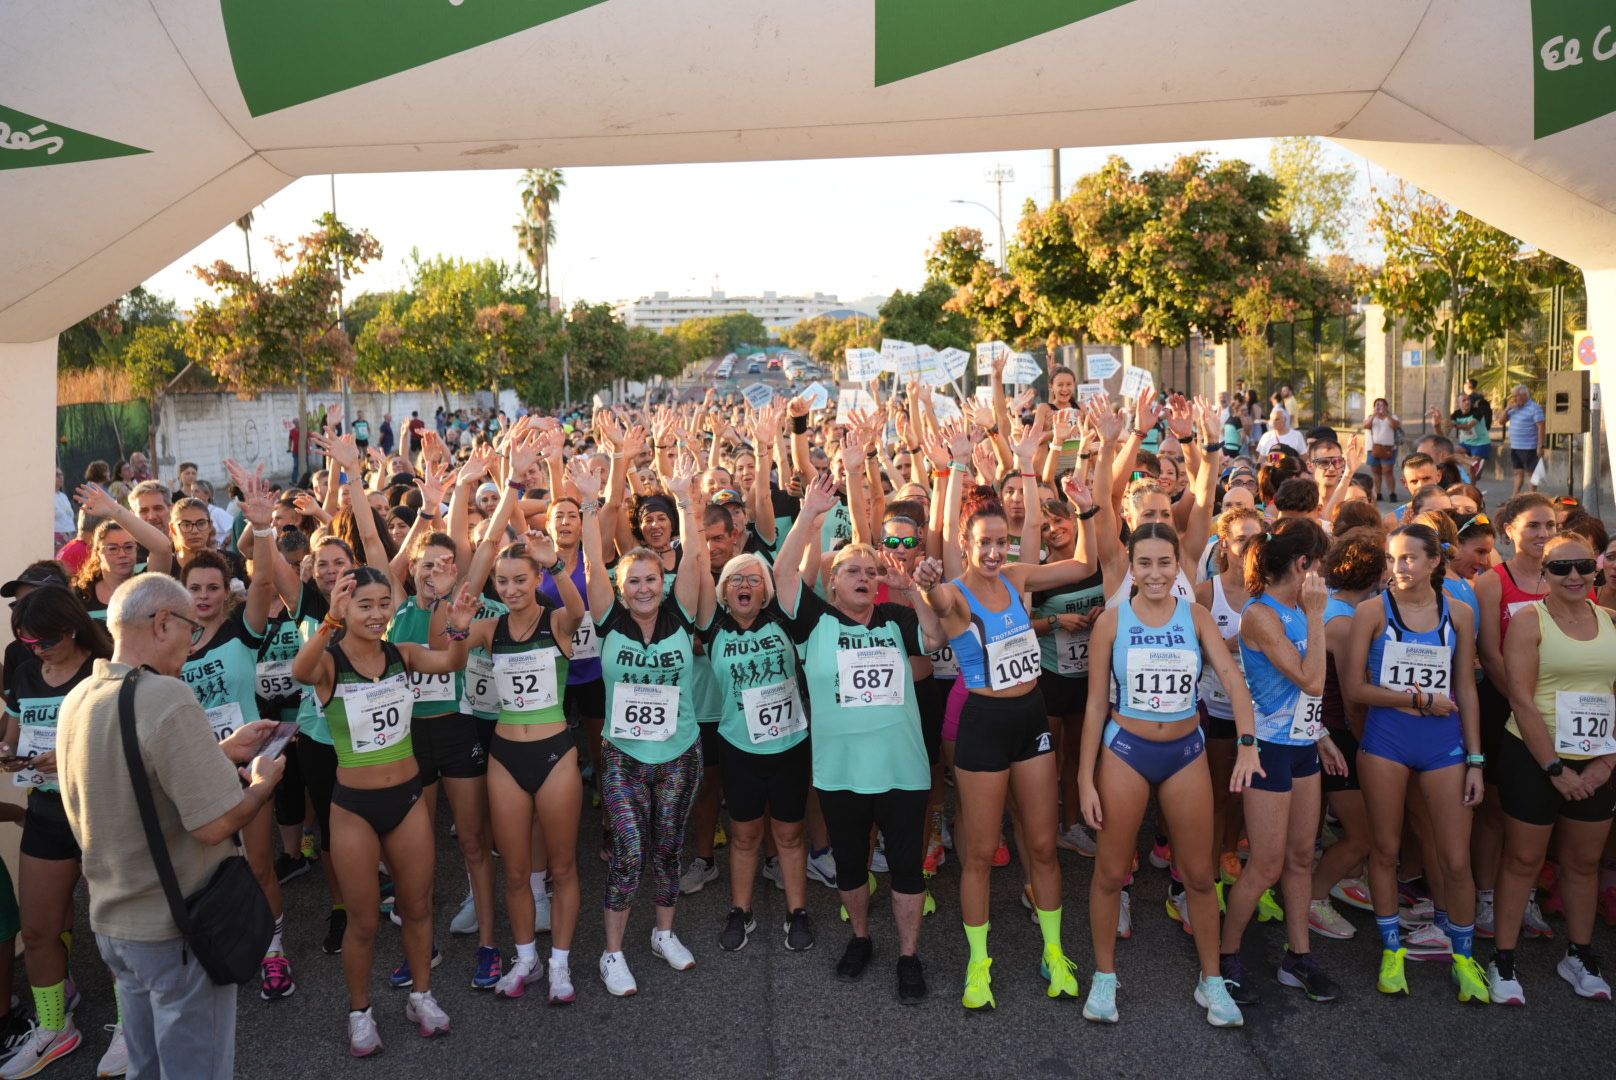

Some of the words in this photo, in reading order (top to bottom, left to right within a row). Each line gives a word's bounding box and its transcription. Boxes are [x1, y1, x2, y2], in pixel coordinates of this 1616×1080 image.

[1541, 35, 1583, 71] El
[1593, 25, 1616, 61] C
[1130, 631, 1186, 647] nerja
[853, 668, 894, 690] 687
[996, 652, 1040, 684] 1045
[1388, 665, 1447, 689] 1132
[260, 676, 293, 693] 953
[512, 674, 539, 695] 52
[1134, 673, 1192, 695] 1118
[372, 706, 400, 732] 50
[625, 705, 666, 726] 683
[758, 700, 793, 731] 677
[1572, 716, 1608, 738] 120
